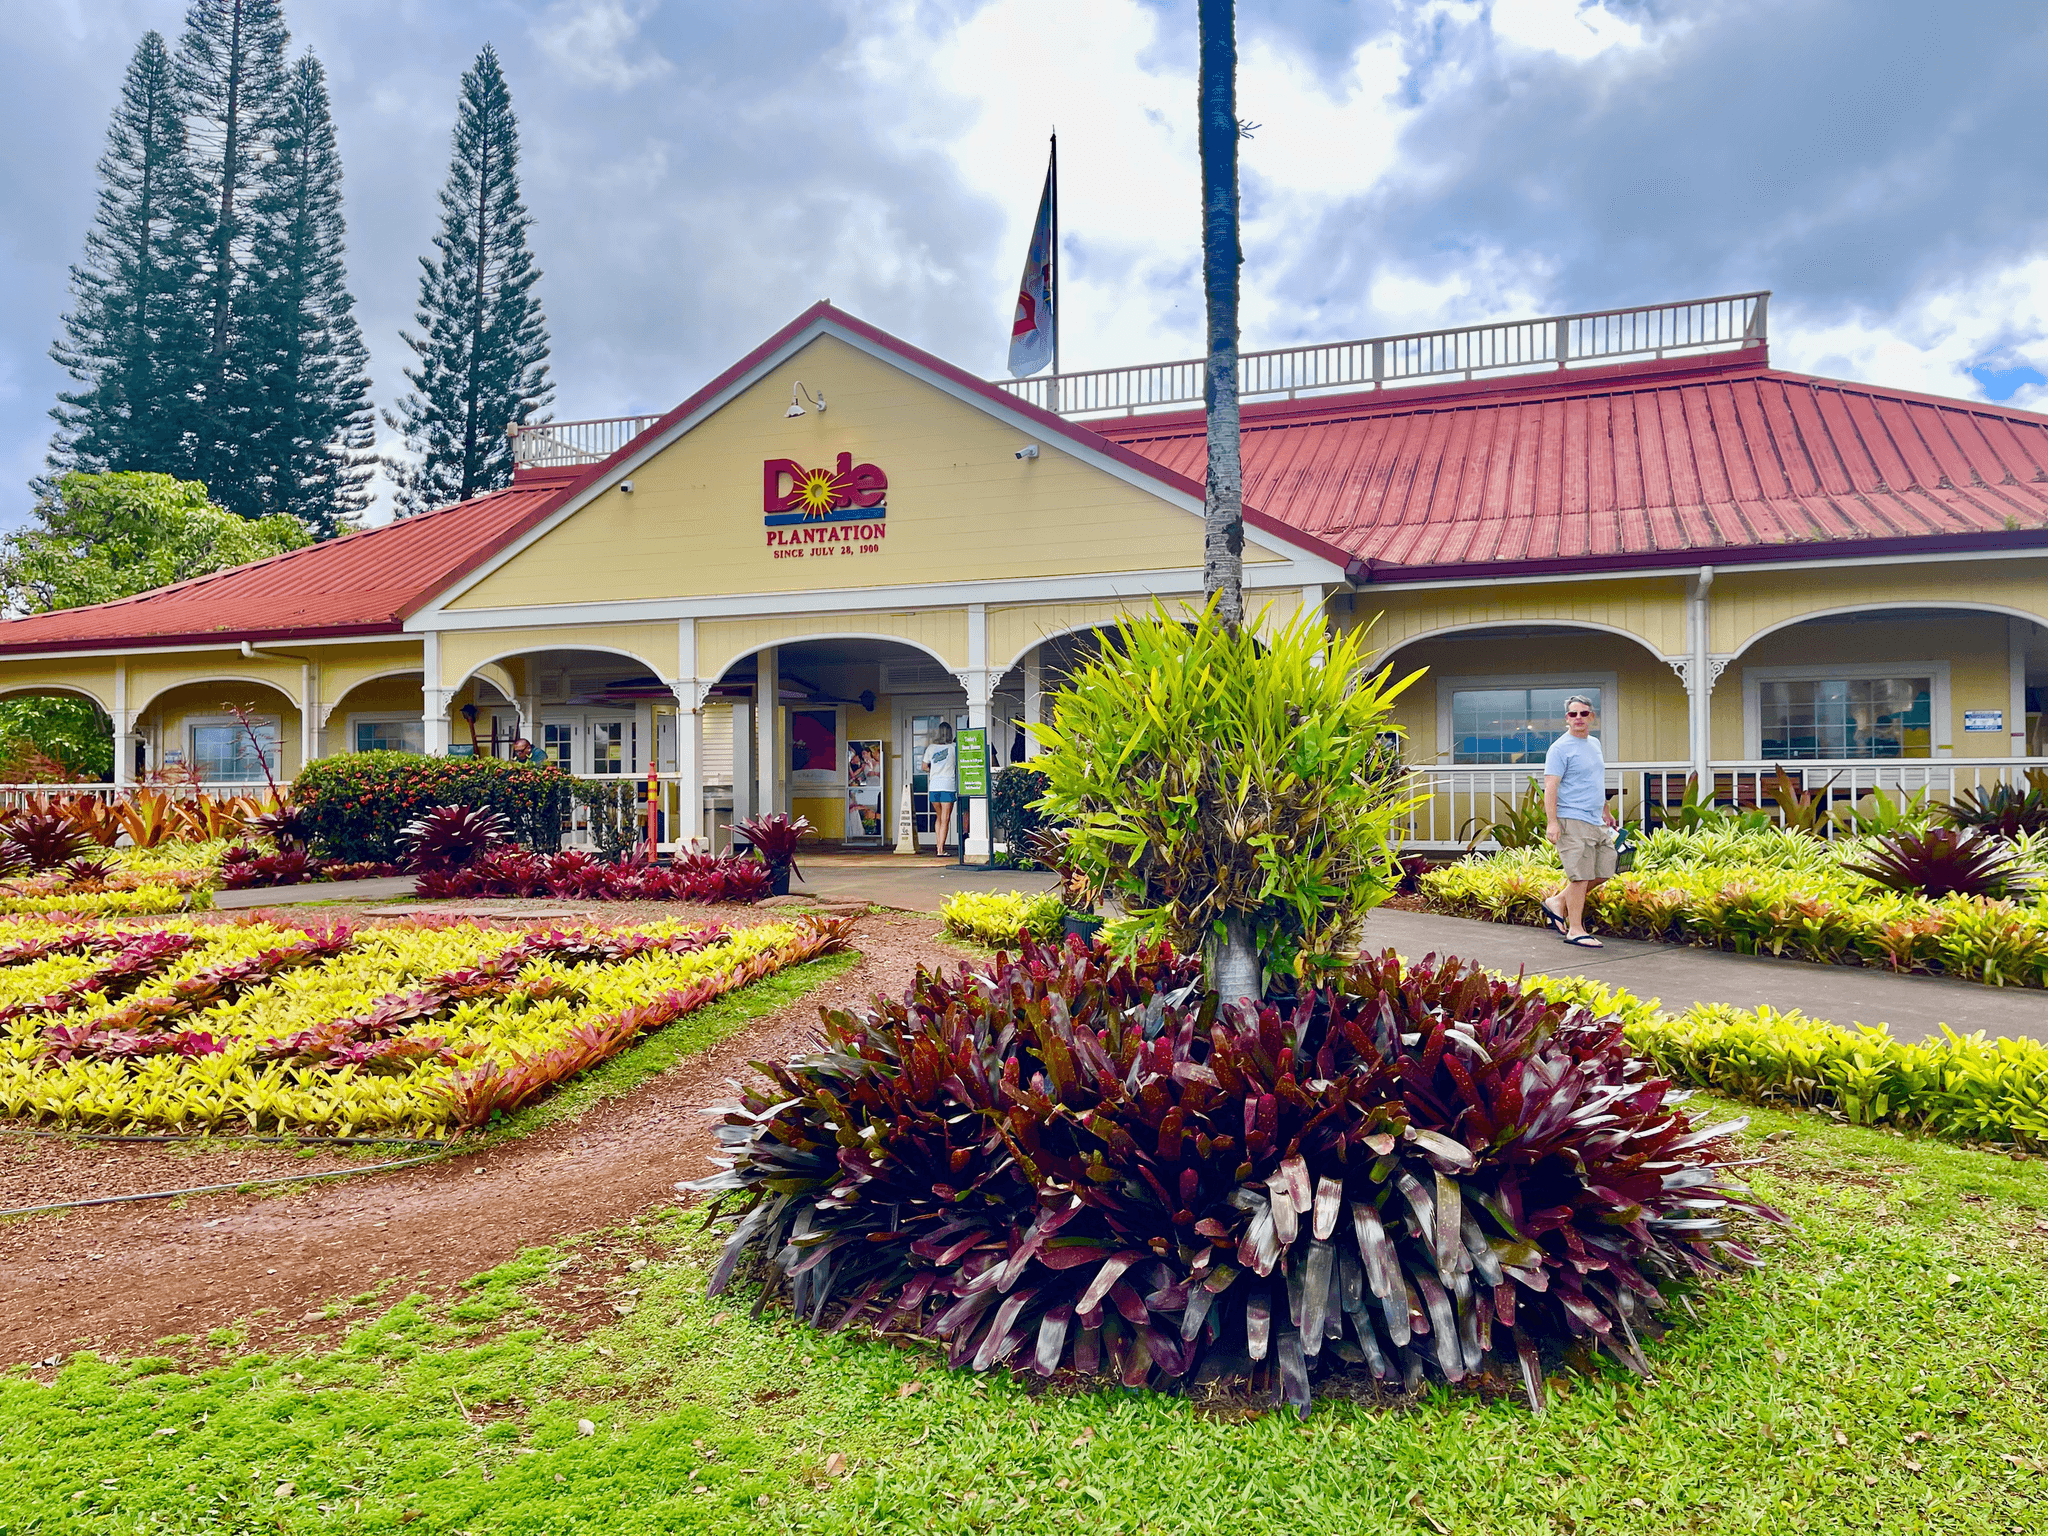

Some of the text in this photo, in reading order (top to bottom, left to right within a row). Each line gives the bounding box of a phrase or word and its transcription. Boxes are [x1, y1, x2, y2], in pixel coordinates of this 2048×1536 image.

[764, 451, 888, 513] Dole
[766, 523, 886, 546] PLANTATION
[773, 544, 879, 559] SINCE JULY 28, 1900
